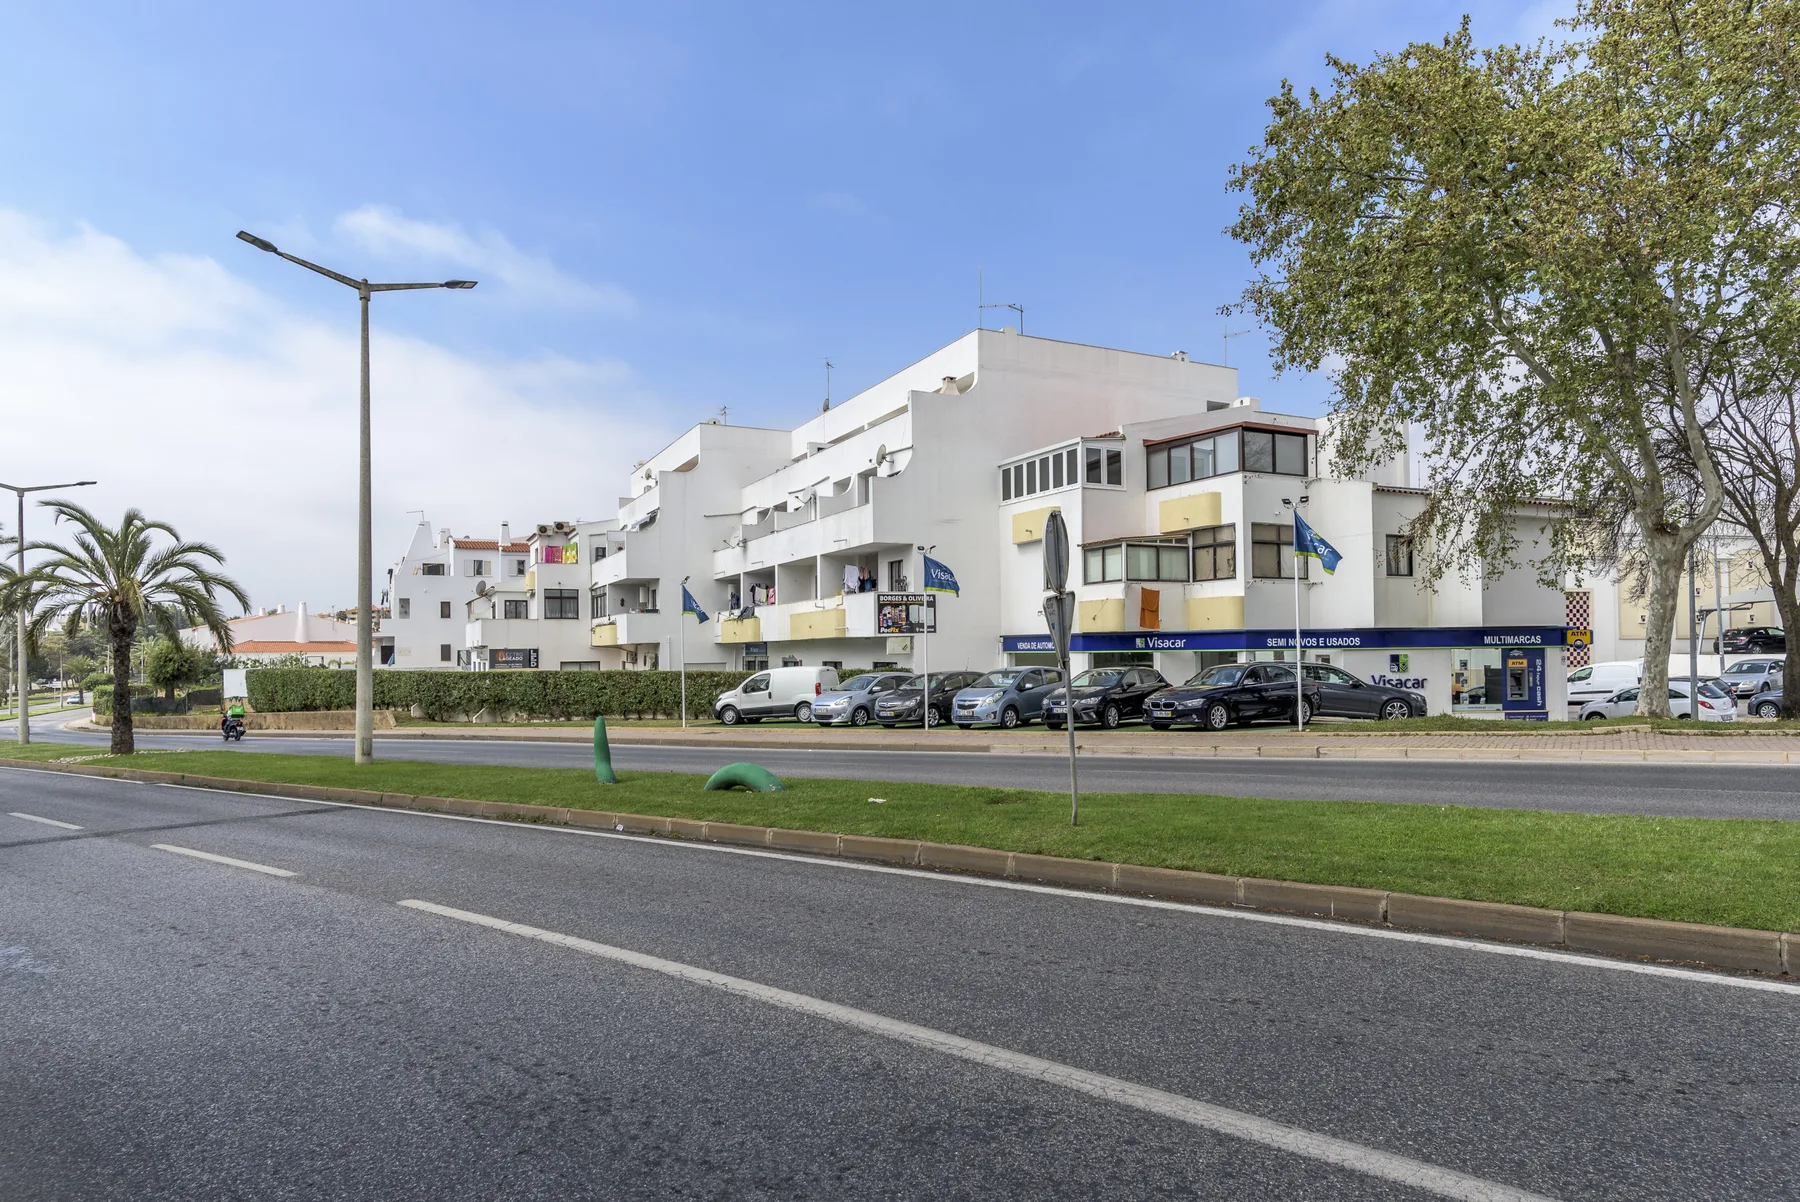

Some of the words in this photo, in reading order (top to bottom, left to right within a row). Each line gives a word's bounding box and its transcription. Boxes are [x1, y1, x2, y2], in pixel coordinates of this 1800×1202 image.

[1146, 637, 1186, 648] Visacar
[1267, 638, 1287, 646] SEMI
[1319, 637, 1324, 646] E
[1326, 637, 1360, 646] USADOS
[1484, 635, 1542, 644] MULTIMARCAS
[1016, 642, 1030, 650] VENDA
[1031, 642, 1037, 650] DE
[1536, 658, 1542, 672] 24
[1371, 674, 1428, 689] Visacar
